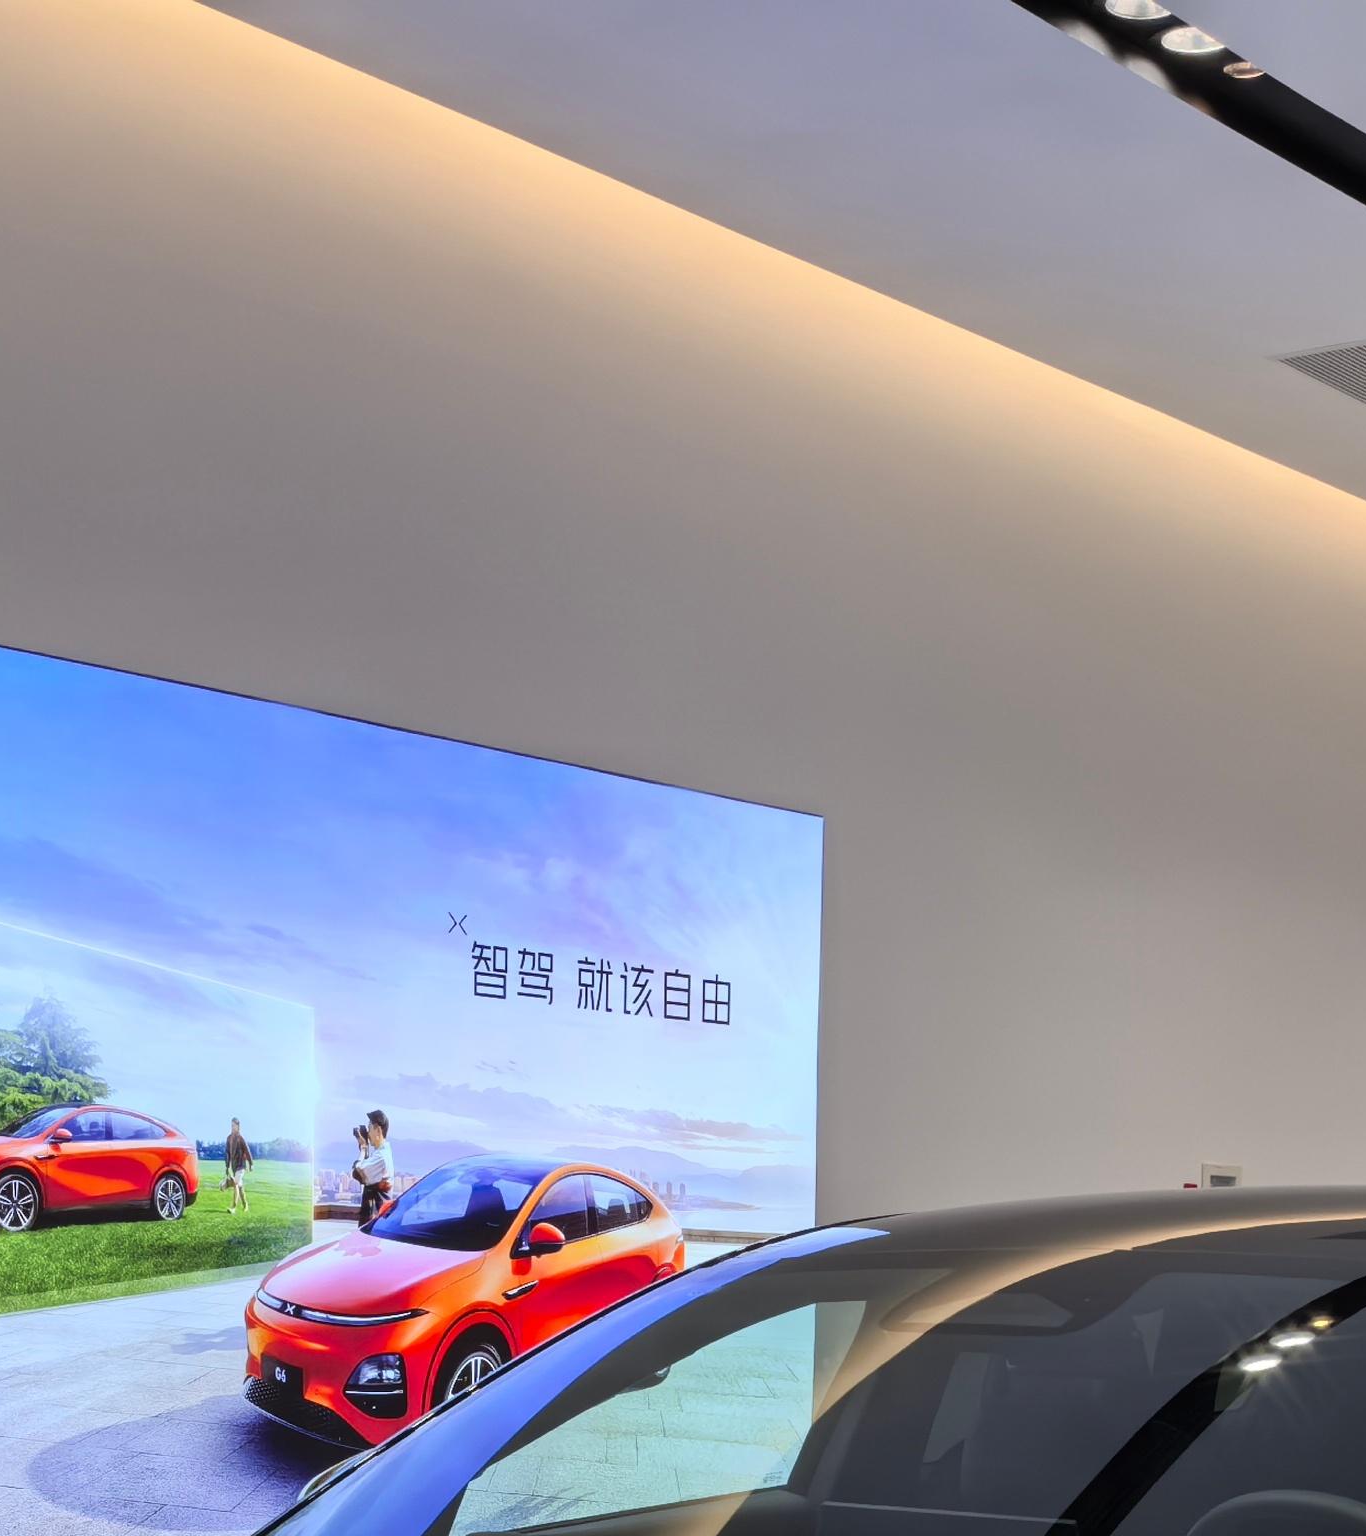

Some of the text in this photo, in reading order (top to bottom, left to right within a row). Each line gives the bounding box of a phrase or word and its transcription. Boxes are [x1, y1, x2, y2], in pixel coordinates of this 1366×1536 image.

[471, 941, 732, 1025] 智驾 就该自由
[275, 1366, 287, 1383] G6
